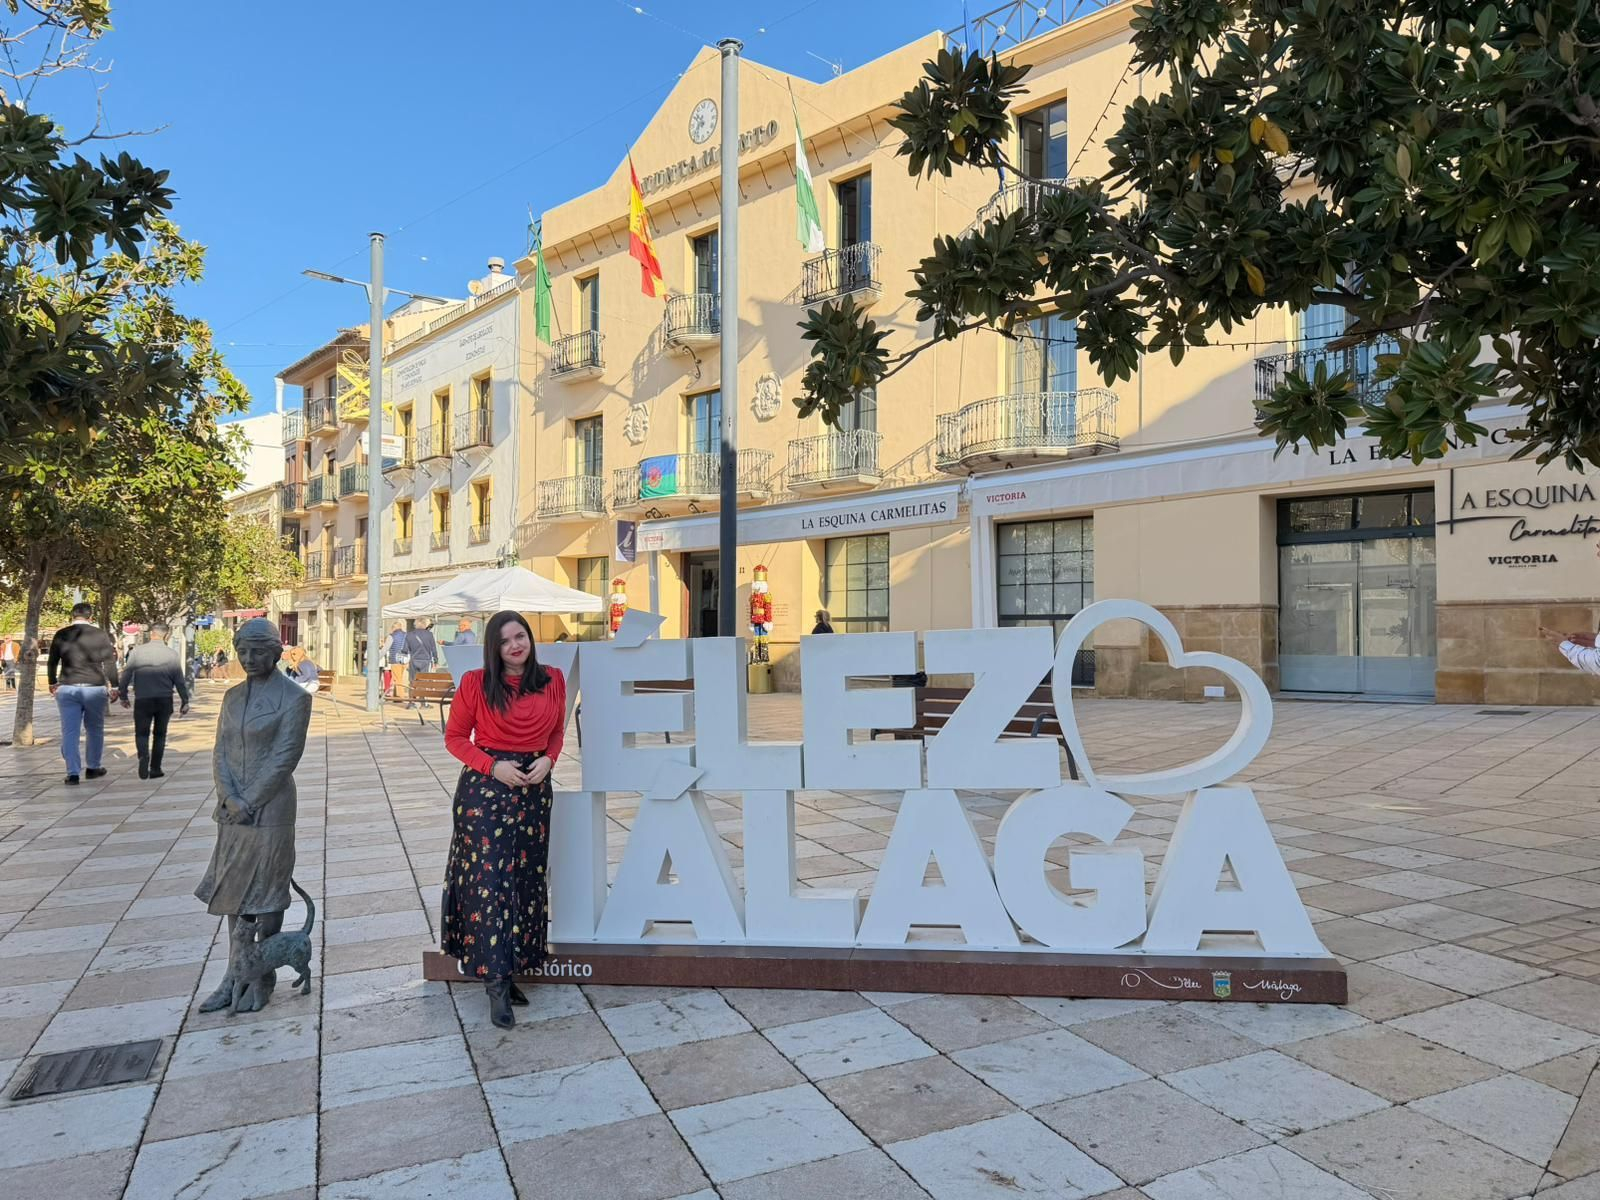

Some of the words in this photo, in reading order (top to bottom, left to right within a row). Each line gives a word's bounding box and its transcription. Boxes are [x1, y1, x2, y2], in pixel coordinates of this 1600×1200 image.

[628, 119, 778, 206] YUNTAMNTO
[1329, 449, 1357, 466] LA
[986, 491, 1026, 503] VICTORIA
[1486, 483, 1596, 509] ESQUINA
[801, 518, 814, 530] LA
[819, 512, 866, 529] ESQUINA
[870, 501, 947, 522] CARMELITAS
[1509, 513, 1600, 542] Carmelita
[1488, 554, 1558, 565] VICTORIA
[517, 959, 593, 977] istórico
